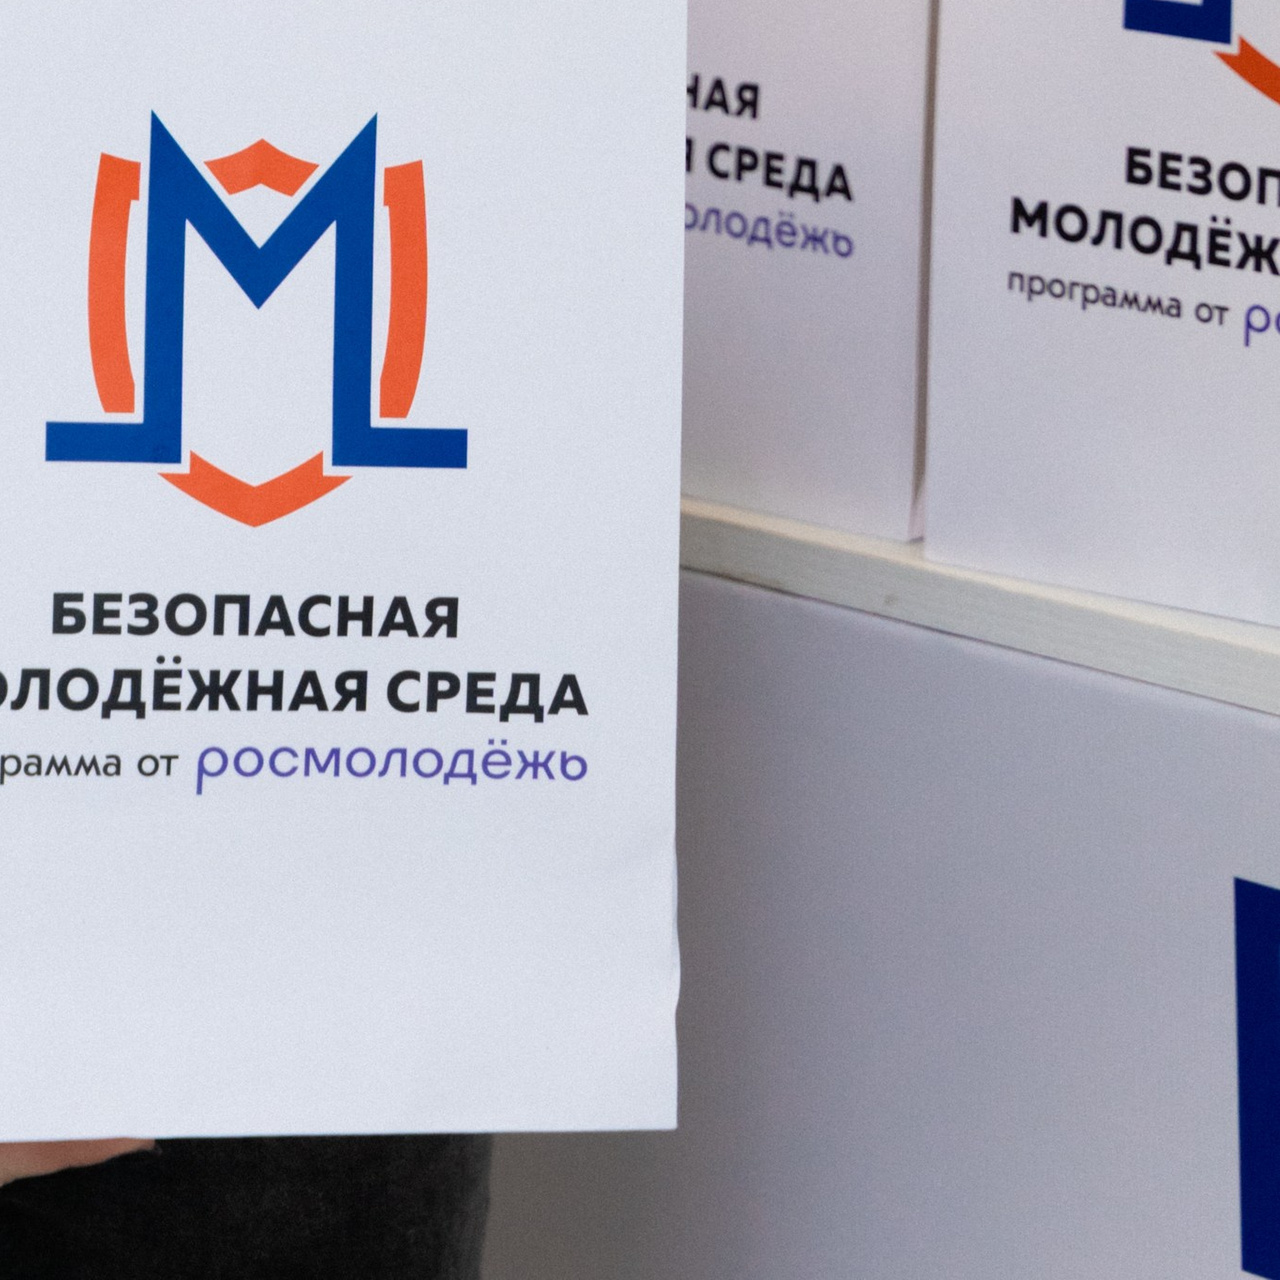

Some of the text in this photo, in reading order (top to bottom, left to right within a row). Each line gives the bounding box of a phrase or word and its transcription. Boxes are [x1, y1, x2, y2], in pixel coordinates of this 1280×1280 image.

[707, 142, 854, 203] СРЕДА
[1010, 196, 1280, 277] МОЛОДЁЖ
[1007, 271, 1182, 318] программа
[1195, 302, 1230, 326] от
[52, 592, 459, 639] БЕЗОПАСНАЯ
[386, 670, 589, 723] СРЕДА
[137, 754, 179, 778] от
[196, 738, 588, 796] росмолодёжь
